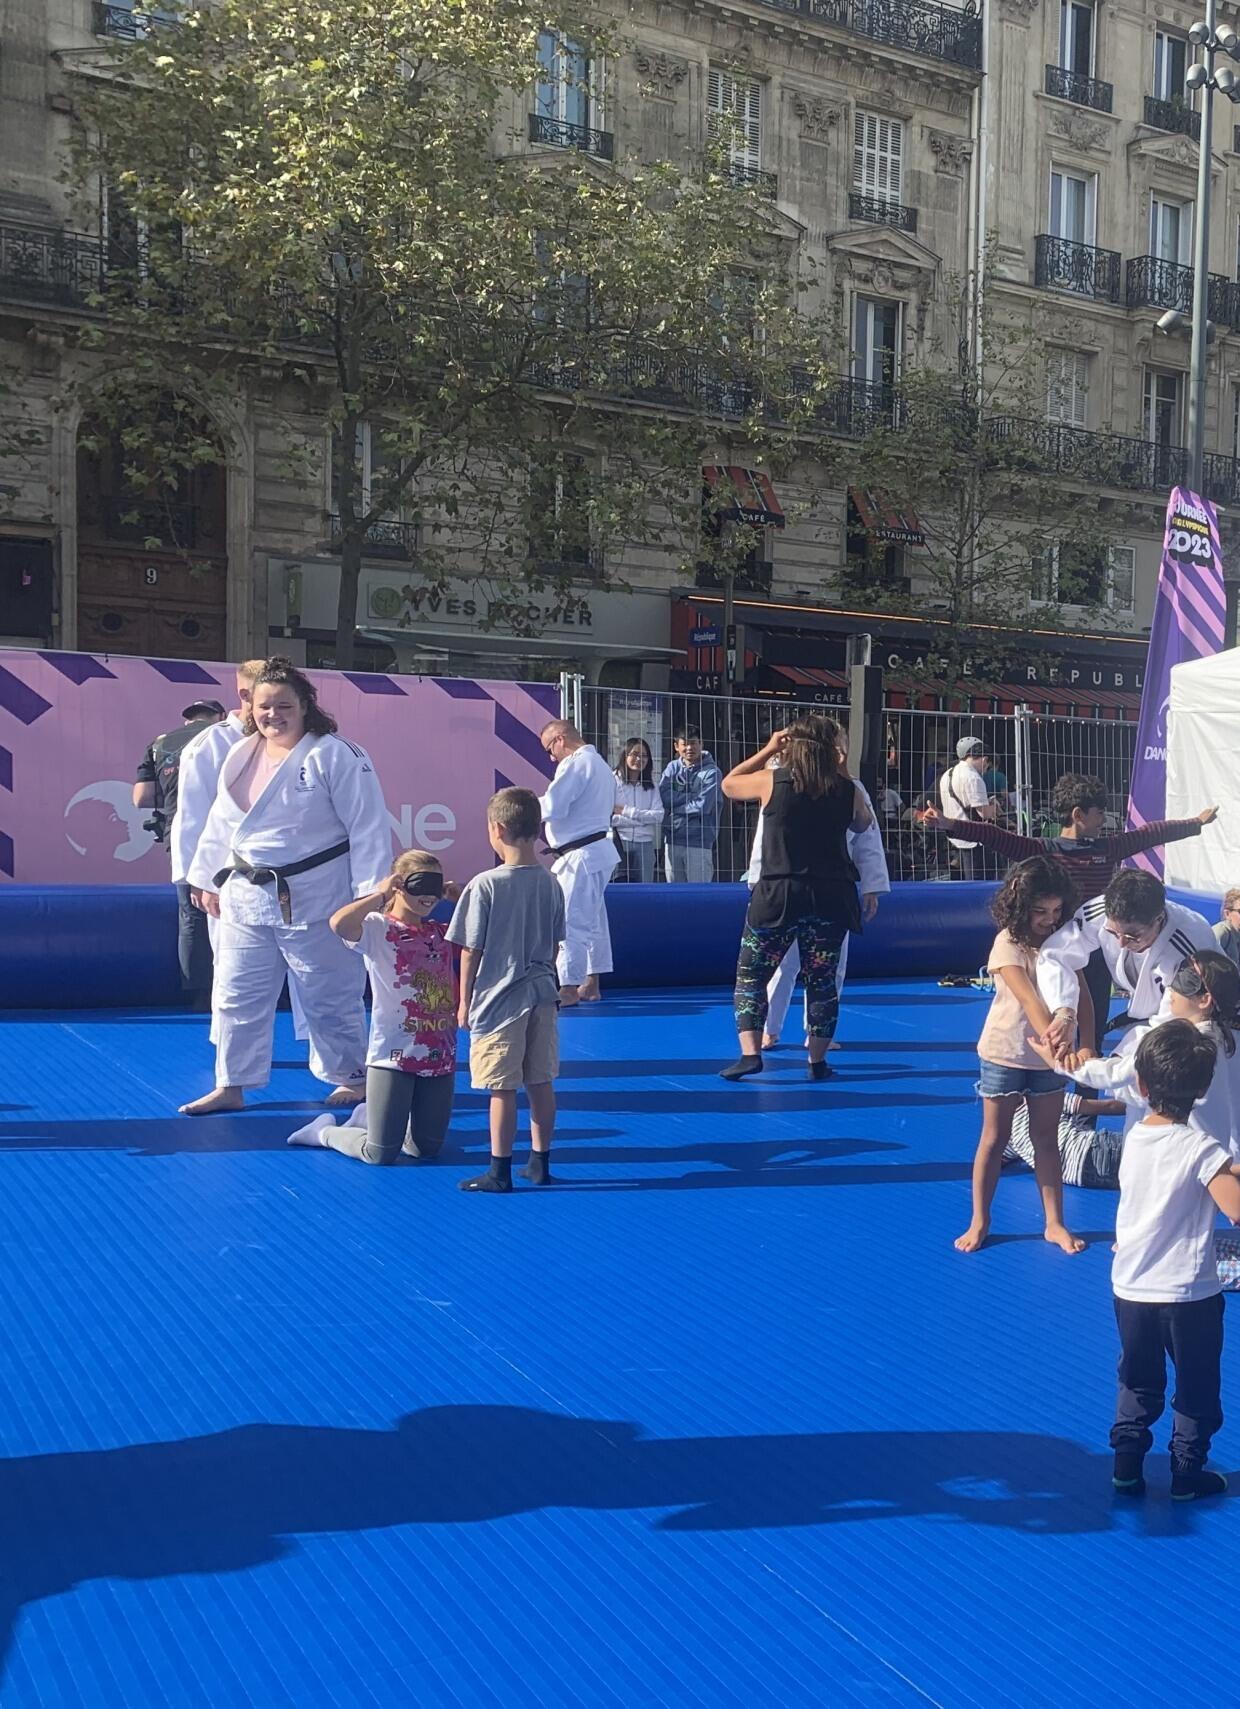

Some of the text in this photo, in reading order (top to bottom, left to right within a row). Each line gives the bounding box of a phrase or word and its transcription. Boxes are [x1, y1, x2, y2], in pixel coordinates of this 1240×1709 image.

[875, 529, 922, 543] ESTAURANT
[1168, 528, 1212, 559] 2023
[146, 567, 157, 584] 9
[487, 602, 593, 626] RCHER
[696, 675, 720, 690] CAF
[1143, 745, 1168, 761] DAN
